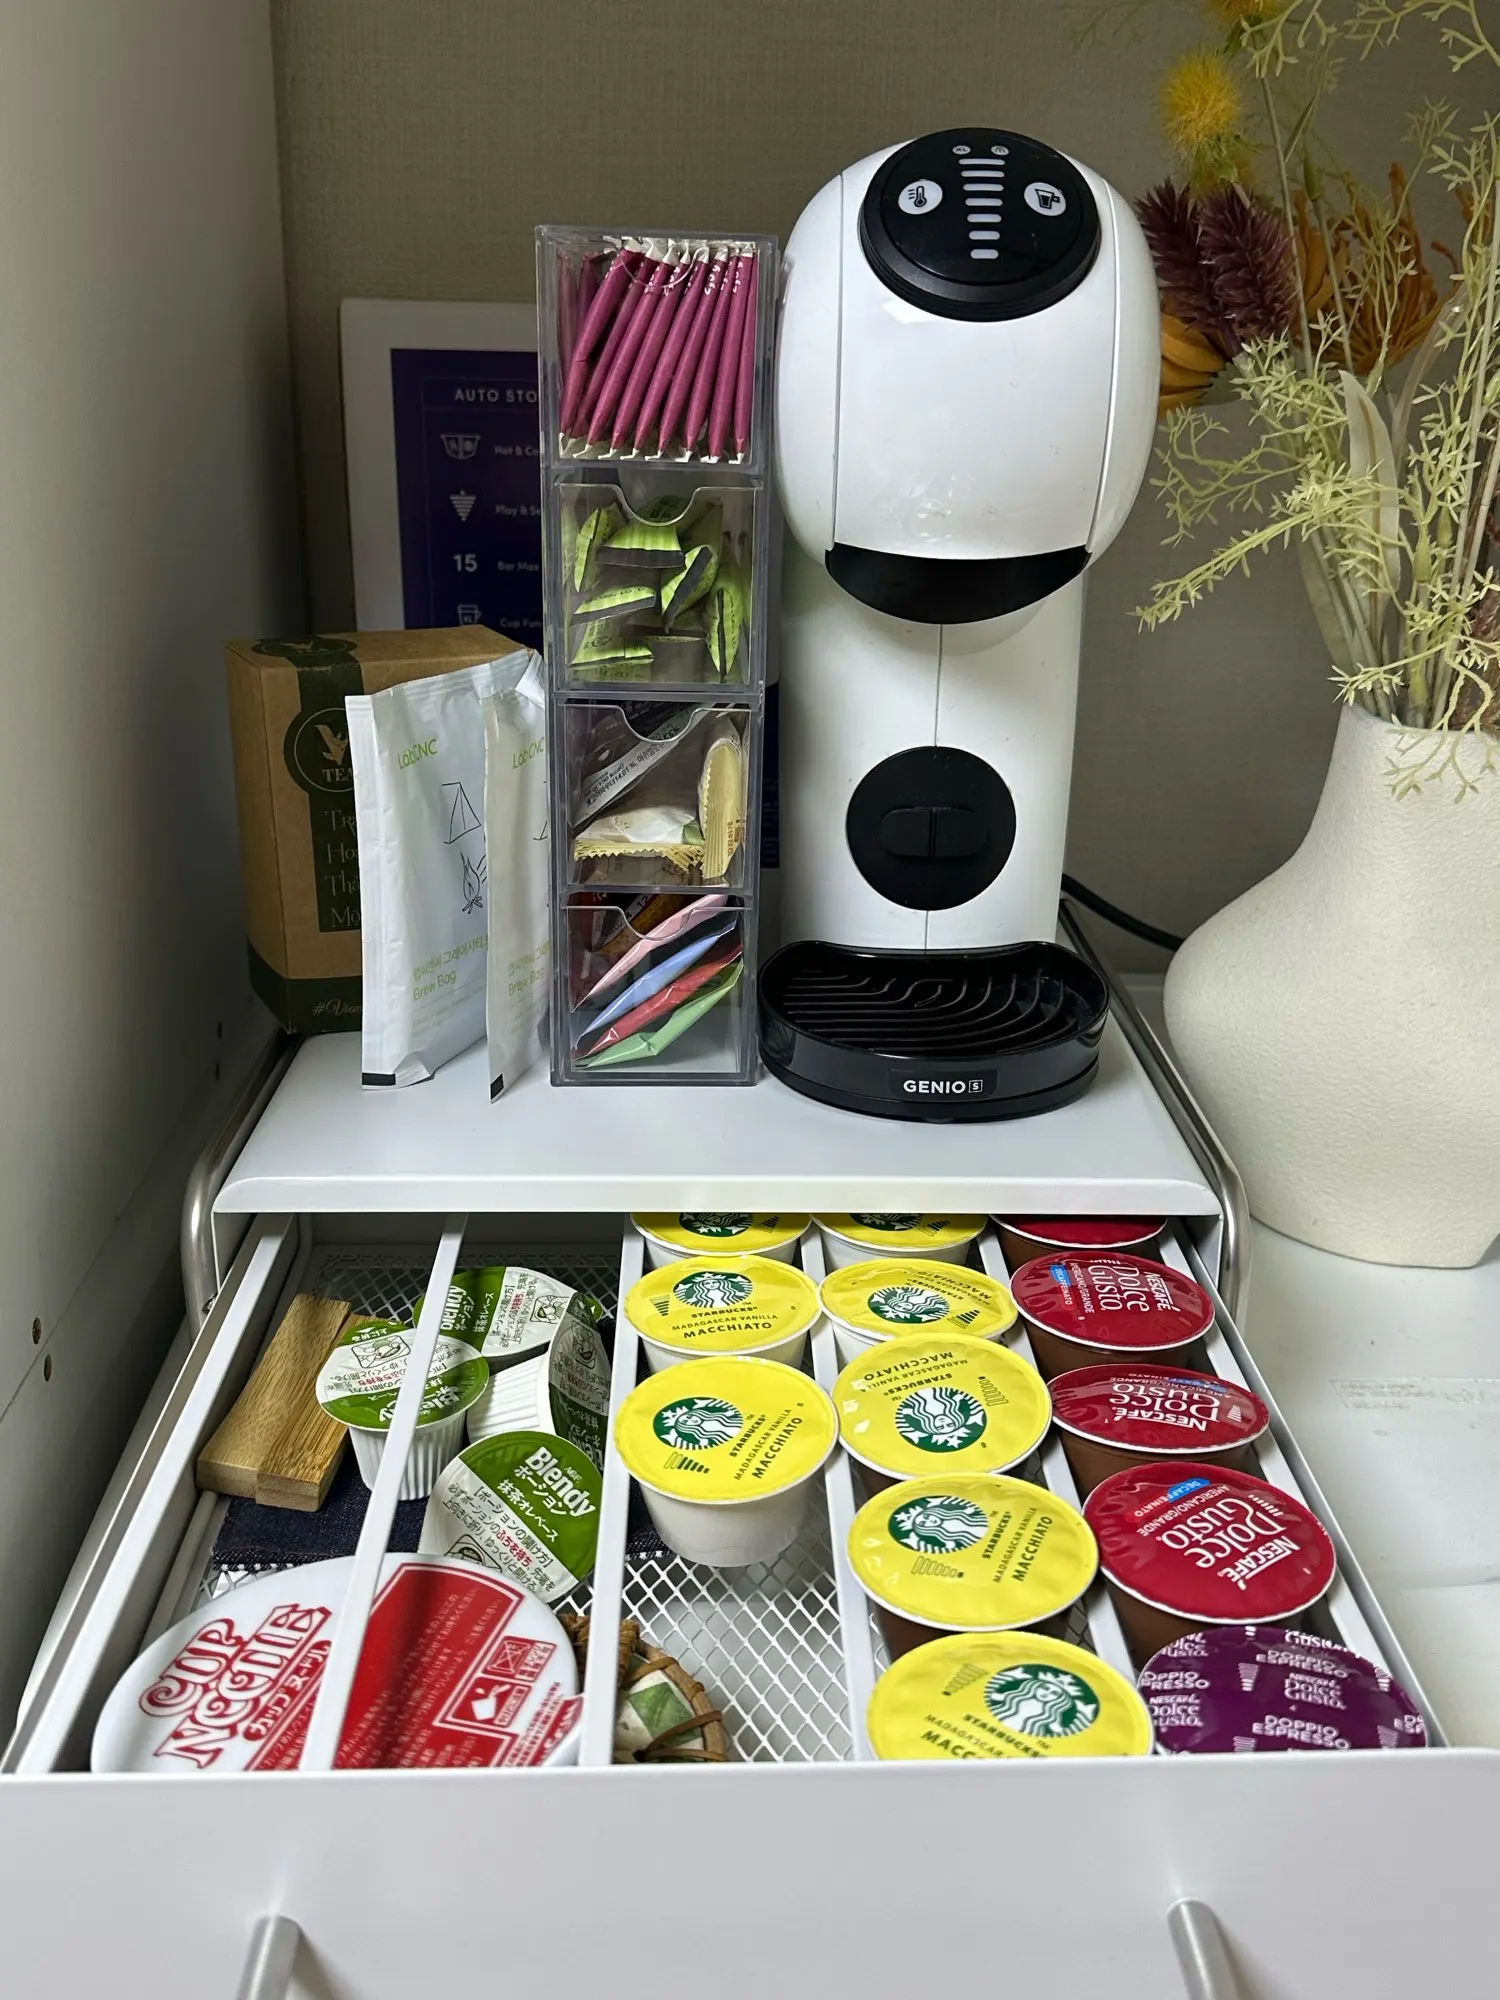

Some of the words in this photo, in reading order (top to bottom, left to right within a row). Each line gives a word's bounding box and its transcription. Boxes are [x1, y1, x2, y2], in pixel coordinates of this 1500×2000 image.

[455, 388, 499, 402] AUTO
[453, 554, 478, 572] 15
[498, 561, 515, 571] Bar
[518, 561, 539, 571] Max
[500, 618, 520, 629] Cup
[398, 738, 437, 770] LabCNC
[413, 981, 436, 1000] Brew
[437, 971, 456, 989] Bag
[903, 1079, 966, 1094] GENIO
[1088, 1264, 1123, 1311] Gusto
[1110, 1265, 1150, 1313] Dolce
[1144, 1271, 1181, 1313] NESCAFÉ
[454, 1296, 475, 1332] ポーション
[672, 1316, 737, 1332] MADAGASCAR
[739, 1313, 778, 1321] VANILLA
[684, 1321, 773, 1339] MACCHIATO
[863, 1351, 954, 1381] MACCHIATO
[902, 1359, 968, 1379] MADAGASCAR
[1109, 1393, 1220, 1423] Dolce
[1112, 1382, 1221, 1408] Gusto
[1113, 1407, 1208, 1432] NESCAFÉ
[734, 1432, 772, 1481] MADAGASCAR
[769, 1408, 792, 1431] VANILLA
[751, 1417, 803, 1479] MACCHIATO
[525, 1446, 597, 1517] Blendy
[563, 1466, 583, 1483] AGF
[514, 1464, 567, 1516] ポーション
[1134, 1479, 1202, 1518] DECAFFEINATO
[497, 1479, 559, 1543] 抹茶オレベース
[1136, 1484, 1230, 1537] AMERICANO/GRANDE
[1160, 1498, 1254, 1550] Gusto
[448, 1482, 556, 1592] 必ずポーションのふちを持ち、先端を
[473, 1485, 554, 1568] 【ポーションの開け方】
[1184, 1511, 1287, 1568] Dolce
[992, 1531, 1023, 1584] MADAGASCAR
[1018, 1507, 1038, 1531] VANILLA
[1011, 1516, 1053, 1582] MACCHIATO
[1222, 1536, 1300, 1591] NESCAFÉ
[139, 1616, 243, 1718] CUP
[1256, 1653, 1348, 1678] ESPRESSO
[1267, 1649, 1336, 1670] DOPPIO
[155, 1602, 332, 1770] NOODLE
[1285, 1679, 1343, 1697] Dolce
[1288, 1672, 1340, 1690] NESCAFÉ
[1149, 1693, 1200, 1705] NESCAFÉ
[1284, 1687, 1341, 1710] Gusto
[1252, 1722, 1350, 1751] ESPRESSO
[1264, 1714, 1339, 1738] DOPPIO
